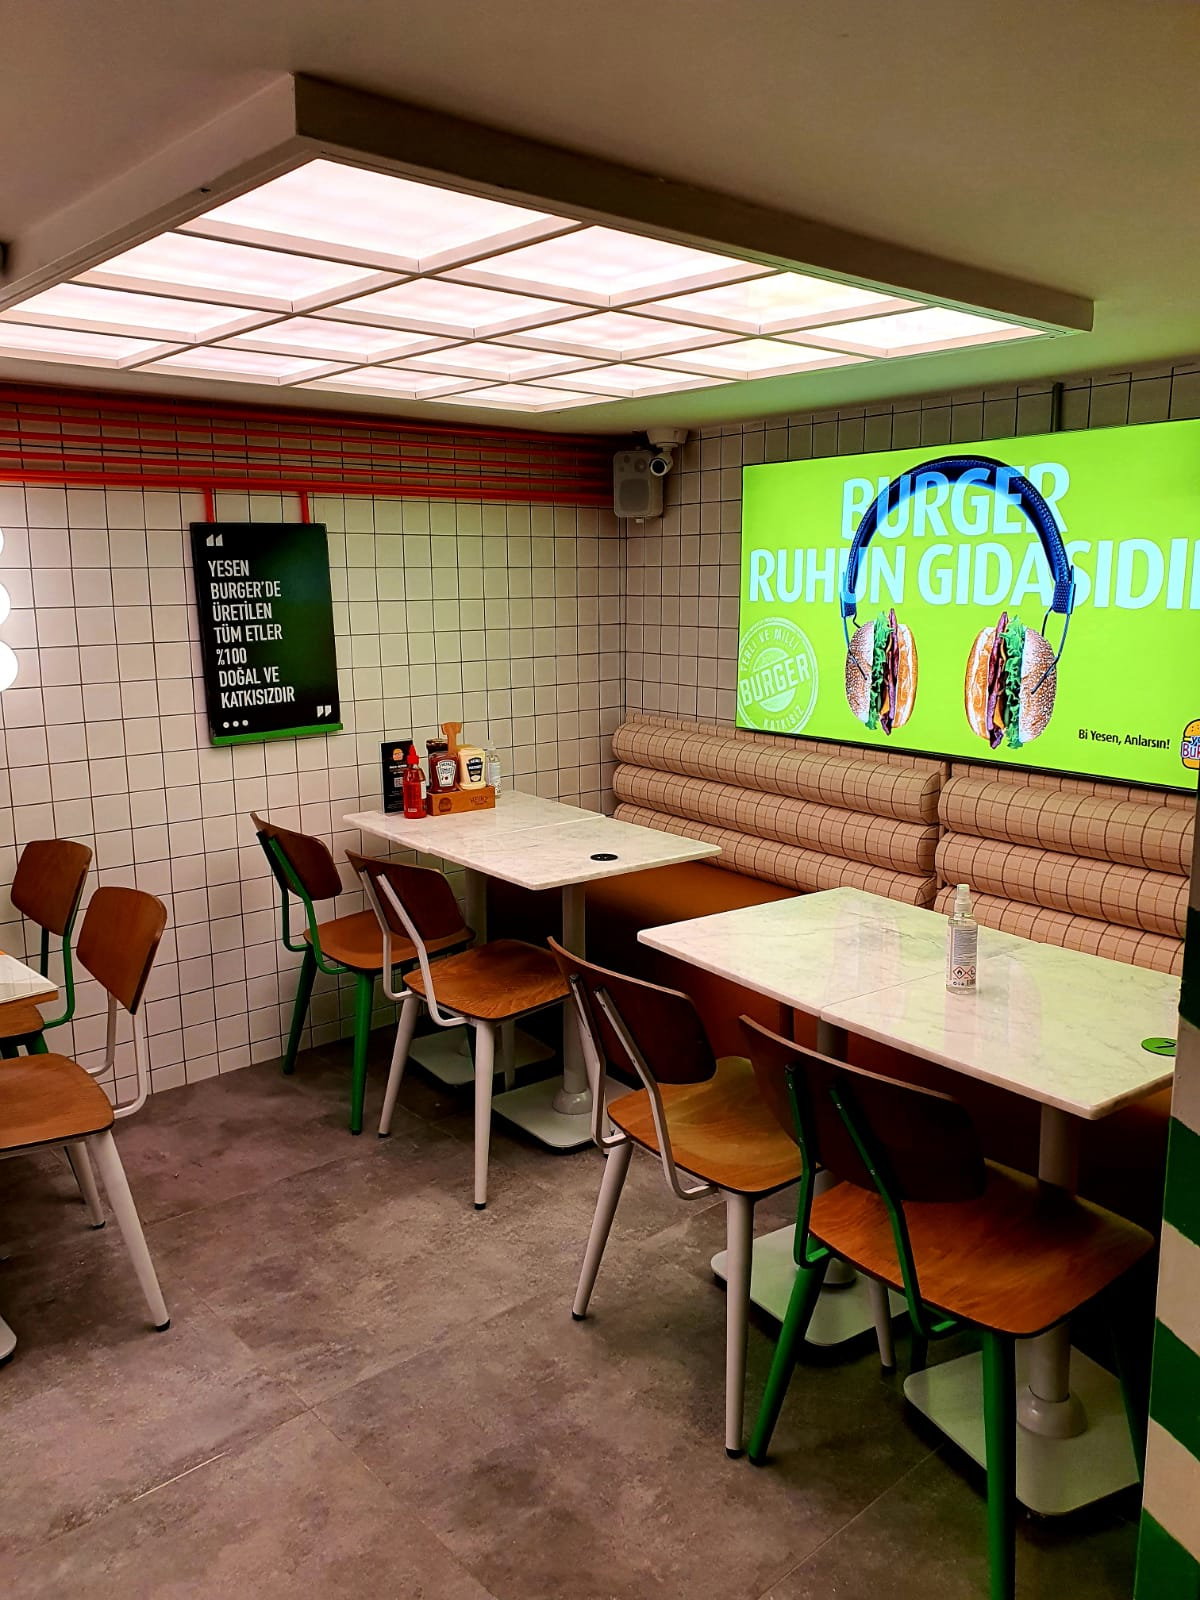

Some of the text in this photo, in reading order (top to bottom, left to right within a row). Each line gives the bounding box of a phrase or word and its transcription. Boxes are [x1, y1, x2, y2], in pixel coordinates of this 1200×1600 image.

[841, 462, 1070, 540] BURGER
[208, 560, 249, 577] YESEN
[918, 537, 1200, 610] GIDASIDI
[211, 581, 281, 599] BURGER'DE
[213, 601, 272, 622] ÜRETİLEN
[214, 624, 283, 644] TÜM ETLER
[216, 647, 247, 666] %100
[218, 666, 280, 687] DOĞAL VE
[740, 653, 810, 707] BURGER
[221, 686, 295, 709] KATKISIZDIR
[1079, 729, 1170, 749] Bi Yesen, Anlarsın!
